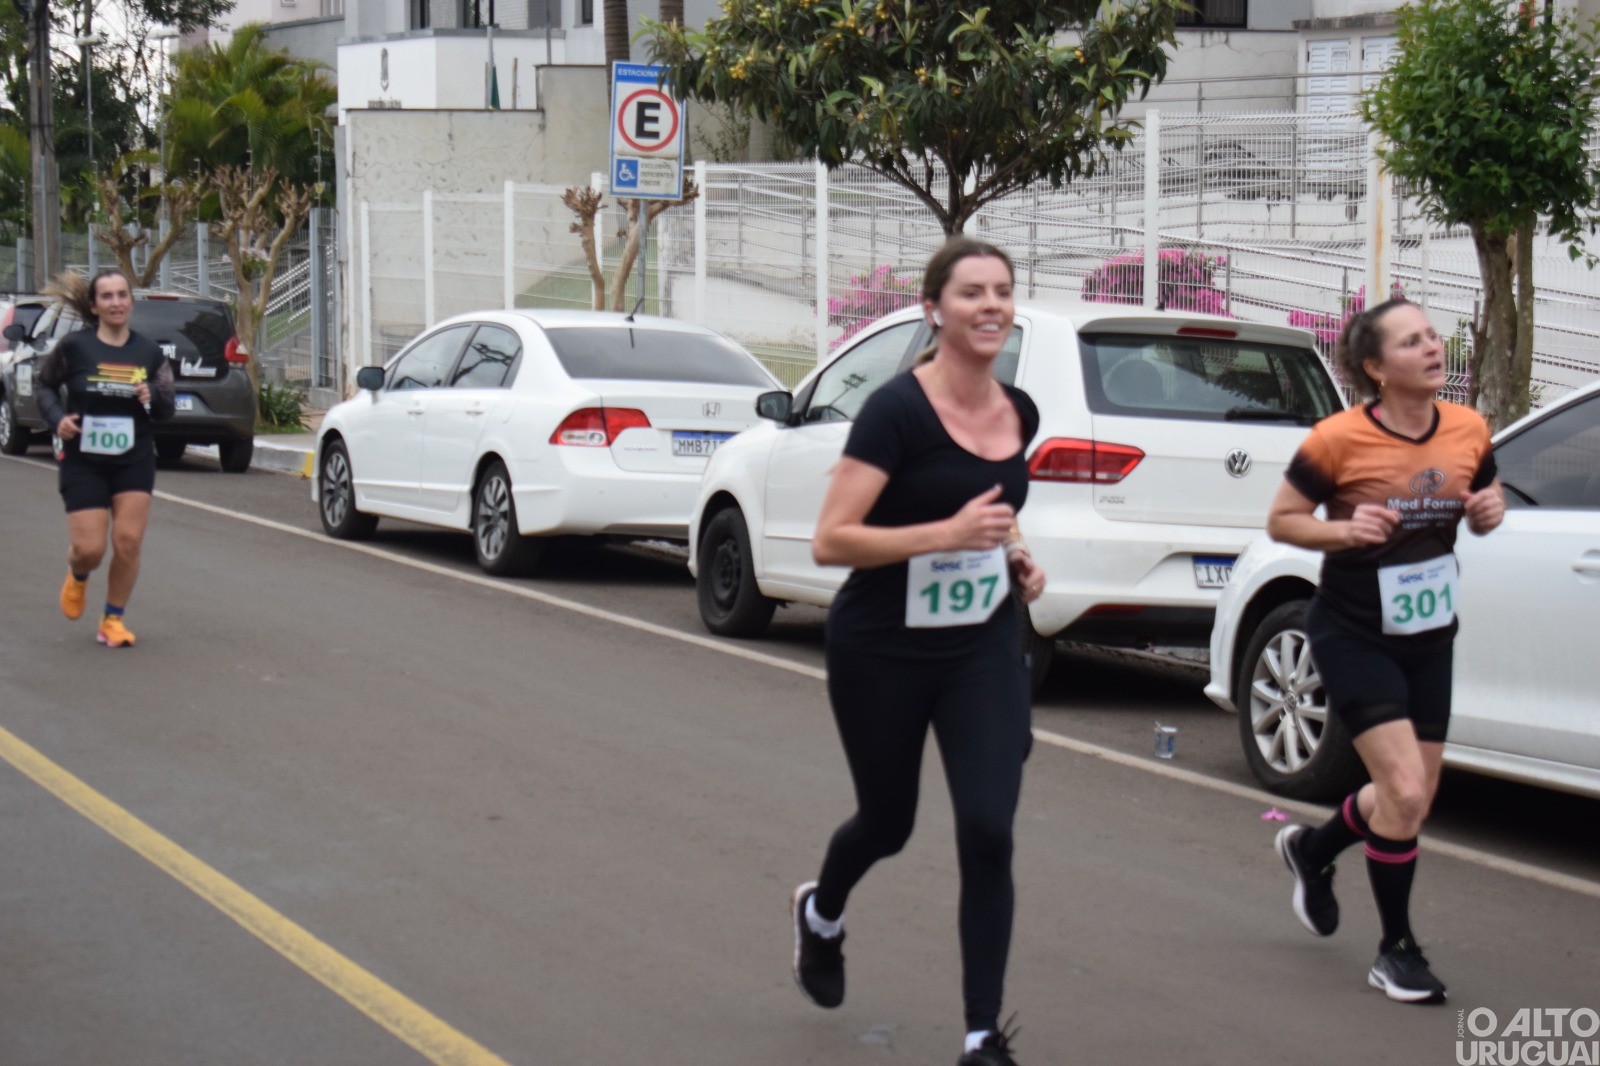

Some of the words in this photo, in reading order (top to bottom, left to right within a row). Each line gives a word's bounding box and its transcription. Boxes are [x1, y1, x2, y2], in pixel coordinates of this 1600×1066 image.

[617, 68, 664, 77] ESTACIONA
[635, 101, 661, 139] E
[88, 432, 128, 449] 100
[1387, 498, 1418, 511] Med
[920, 575, 999, 614] 197
[1392, 582, 1452, 624] 301
